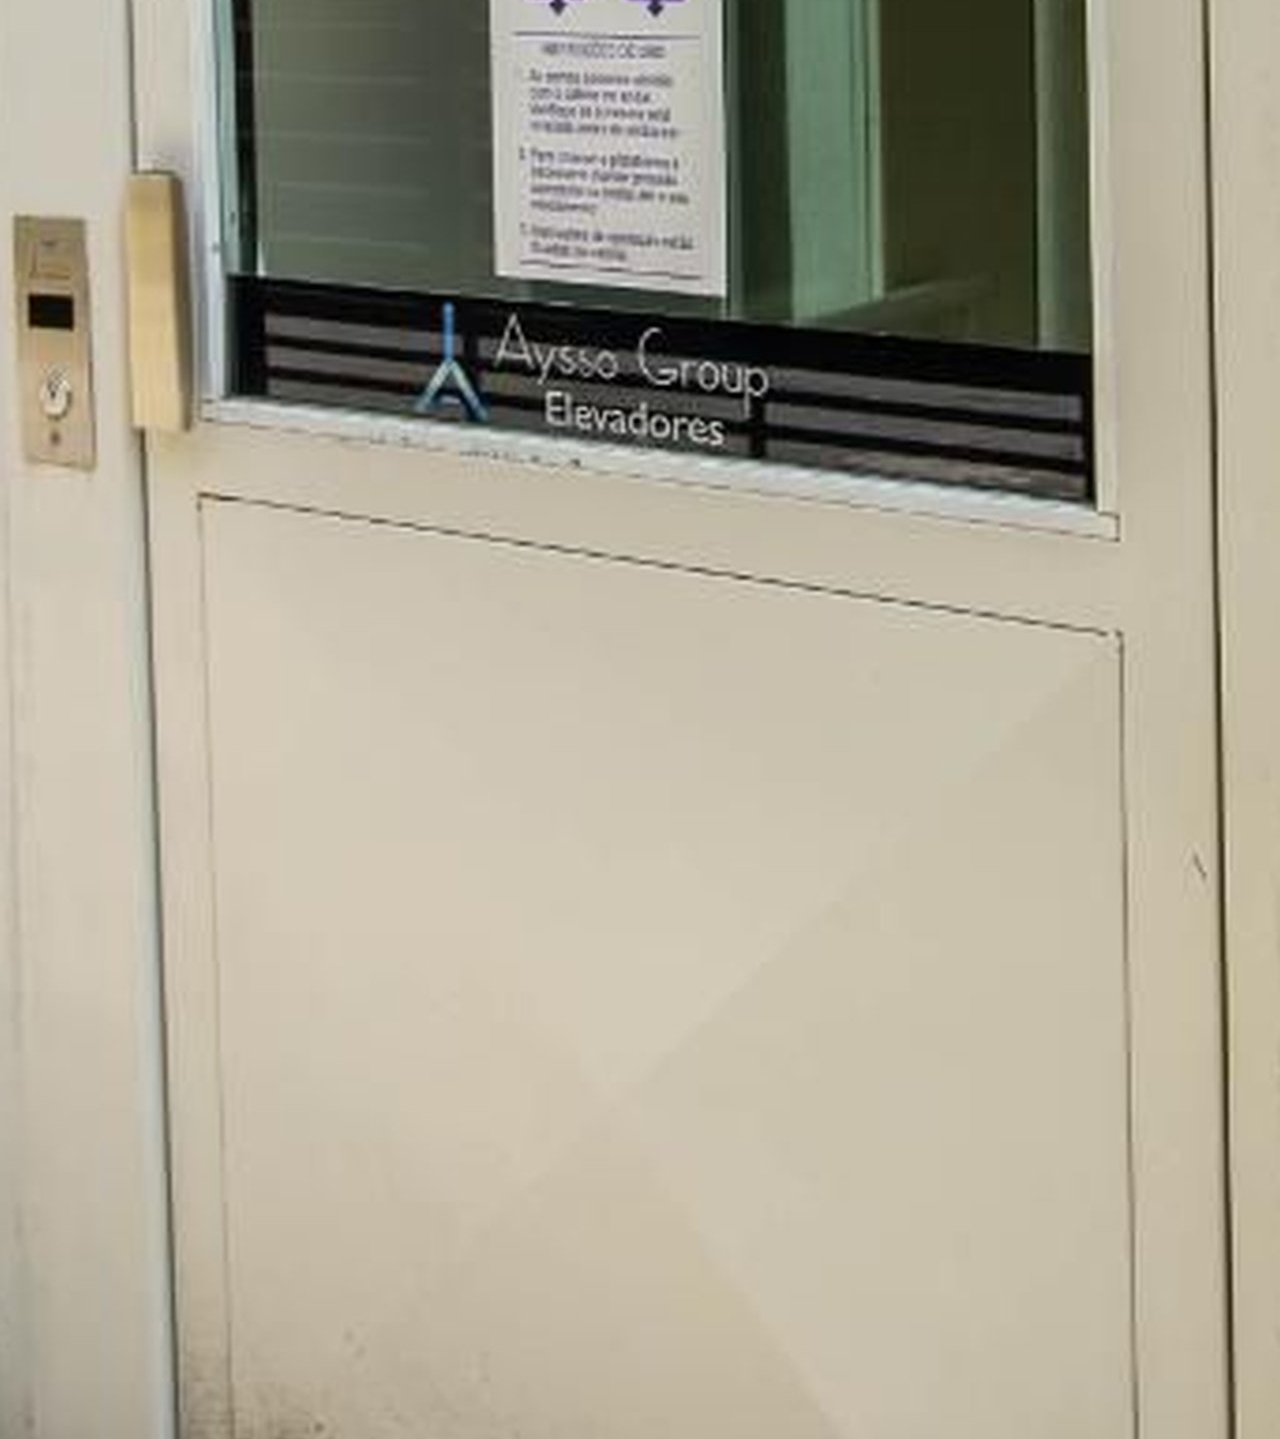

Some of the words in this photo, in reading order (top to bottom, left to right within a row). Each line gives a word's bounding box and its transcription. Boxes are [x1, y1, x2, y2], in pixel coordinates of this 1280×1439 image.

[493, 312, 619, 386] Aysso
[637, 325, 770, 419] Group
[543, 390, 726, 447] Elevadores
